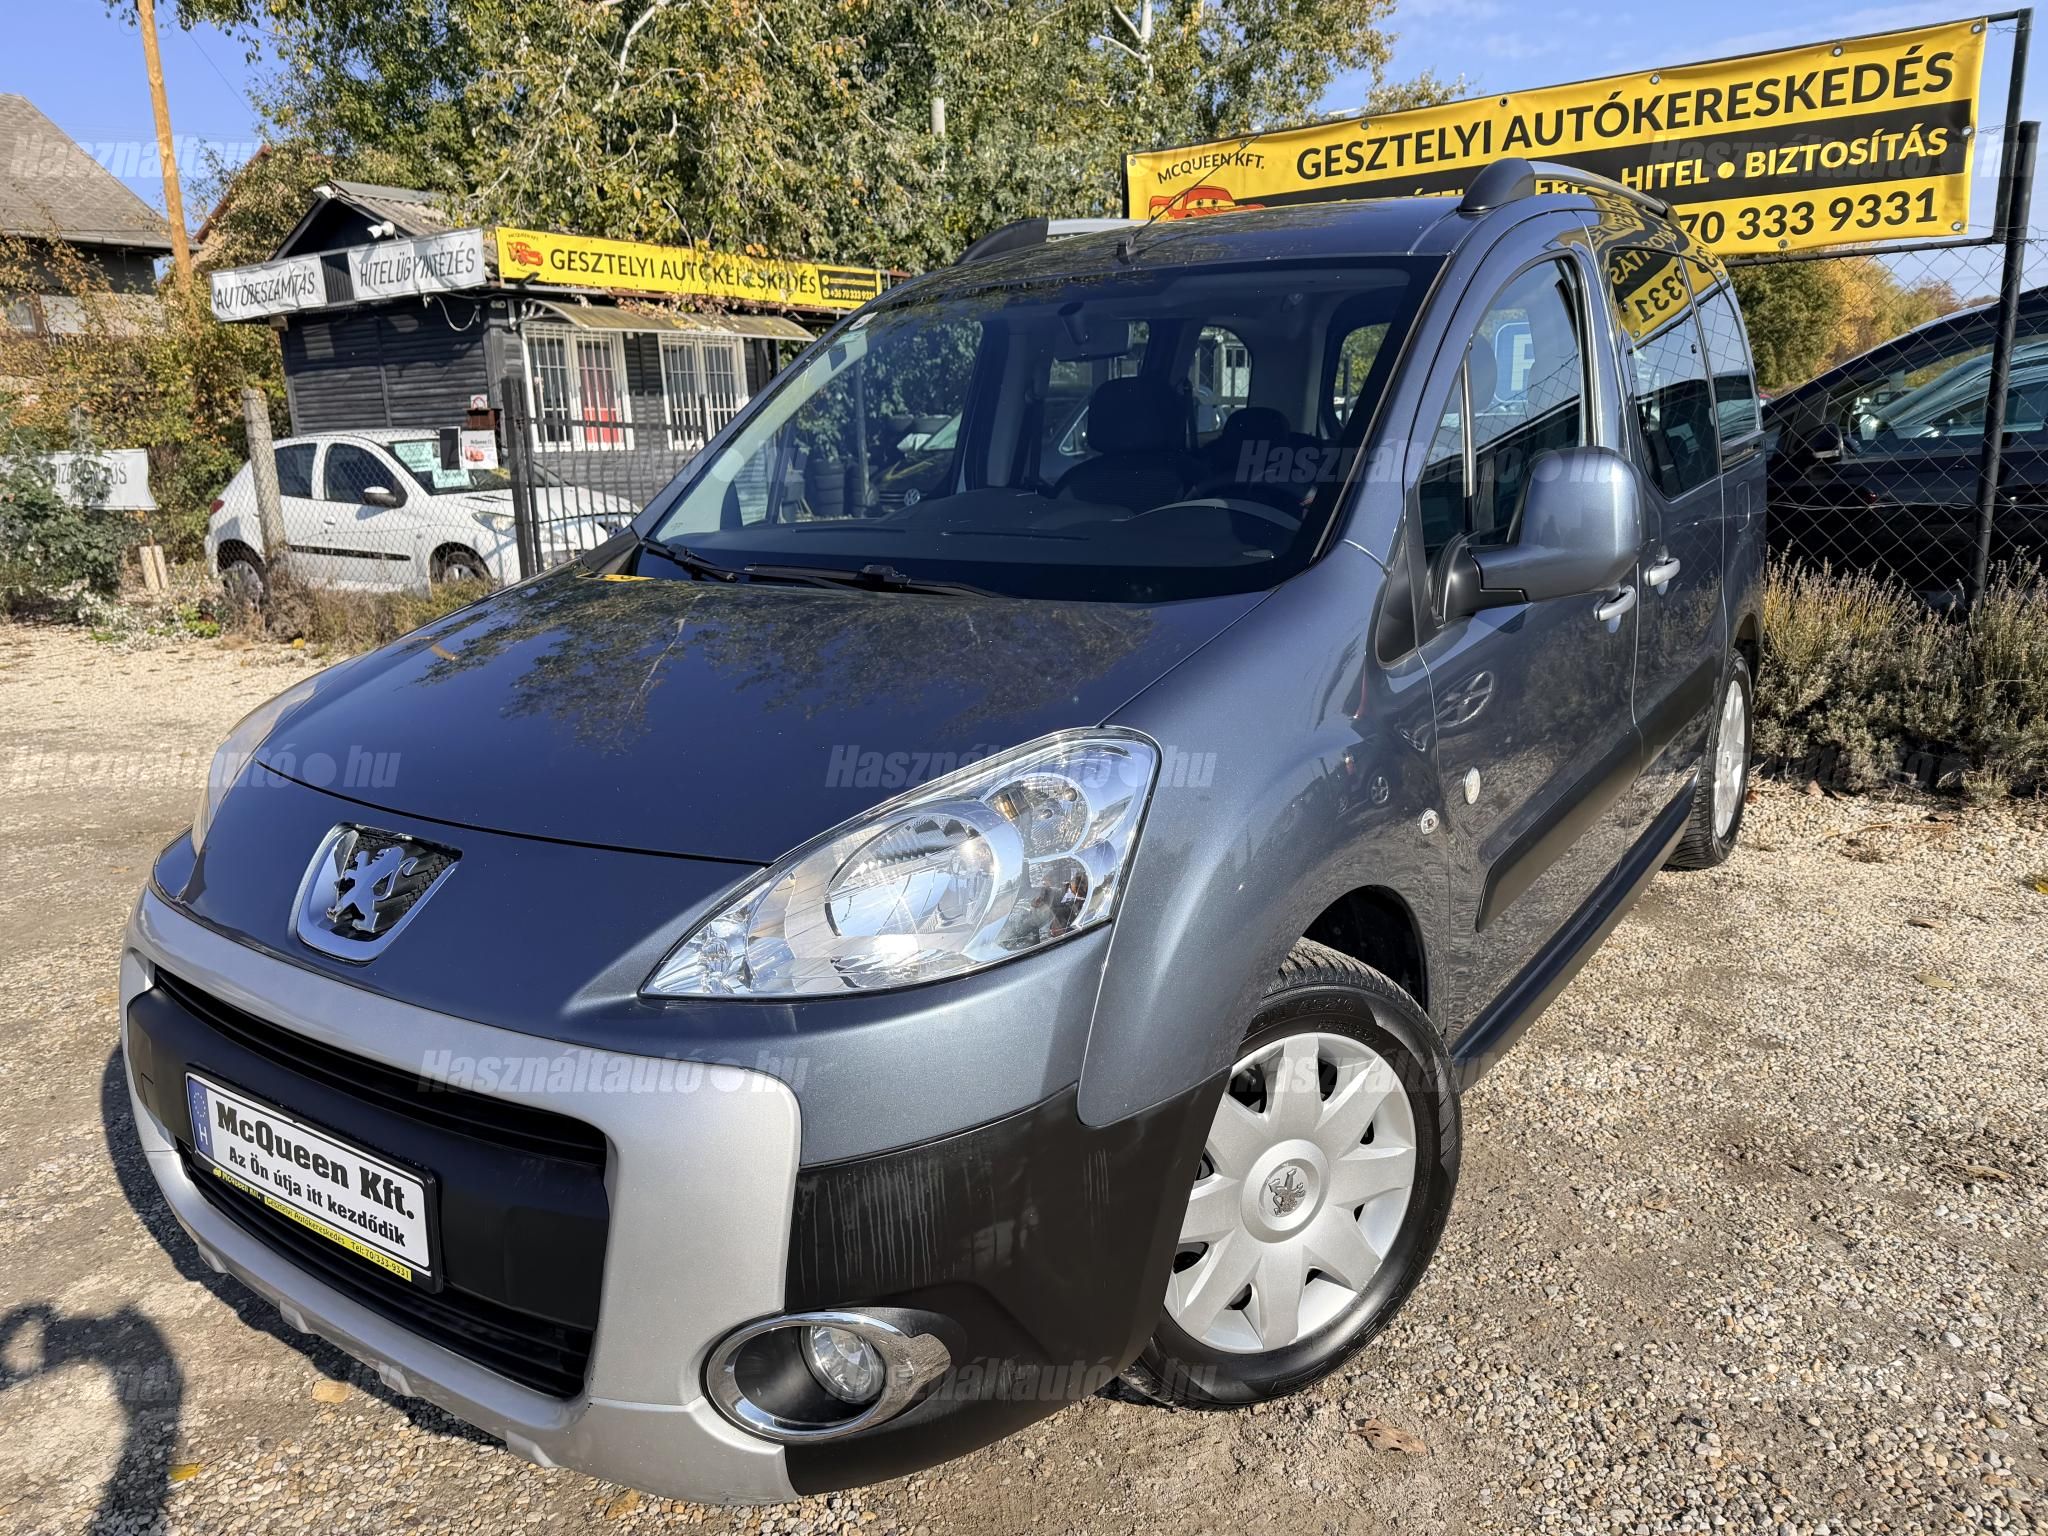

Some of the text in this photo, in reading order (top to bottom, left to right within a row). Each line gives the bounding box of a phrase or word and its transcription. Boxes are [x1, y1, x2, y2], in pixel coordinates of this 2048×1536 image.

[1297, 44, 1954, 181] GESZTELYI AUTÓKERESKEDÉS
[1157, 151, 1265, 184] MCQUEEN KFT.
[1621, 123, 1948, 194] HITEL BIZTOSÍTÁS
[1736, 200, 1815, 241] 333
[1828, 187, 1939, 231] 9331
[216, 266, 315, 310] AUTÓBESZÁMÍTÁS
[360, 244, 476, 288] HITELÜGYINTÉZÉS
[550, 248, 816, 294] GESZTELYI AUTKERESKDÉS
[198, 1122, 209, 1146] H
[215, 1100, 415, 1220] McQueen Kft.
[229, 1146, 406, 1248] Az Ön útja itt kezdődik
[294, 1212, 345, 1245] Autókereskedés
